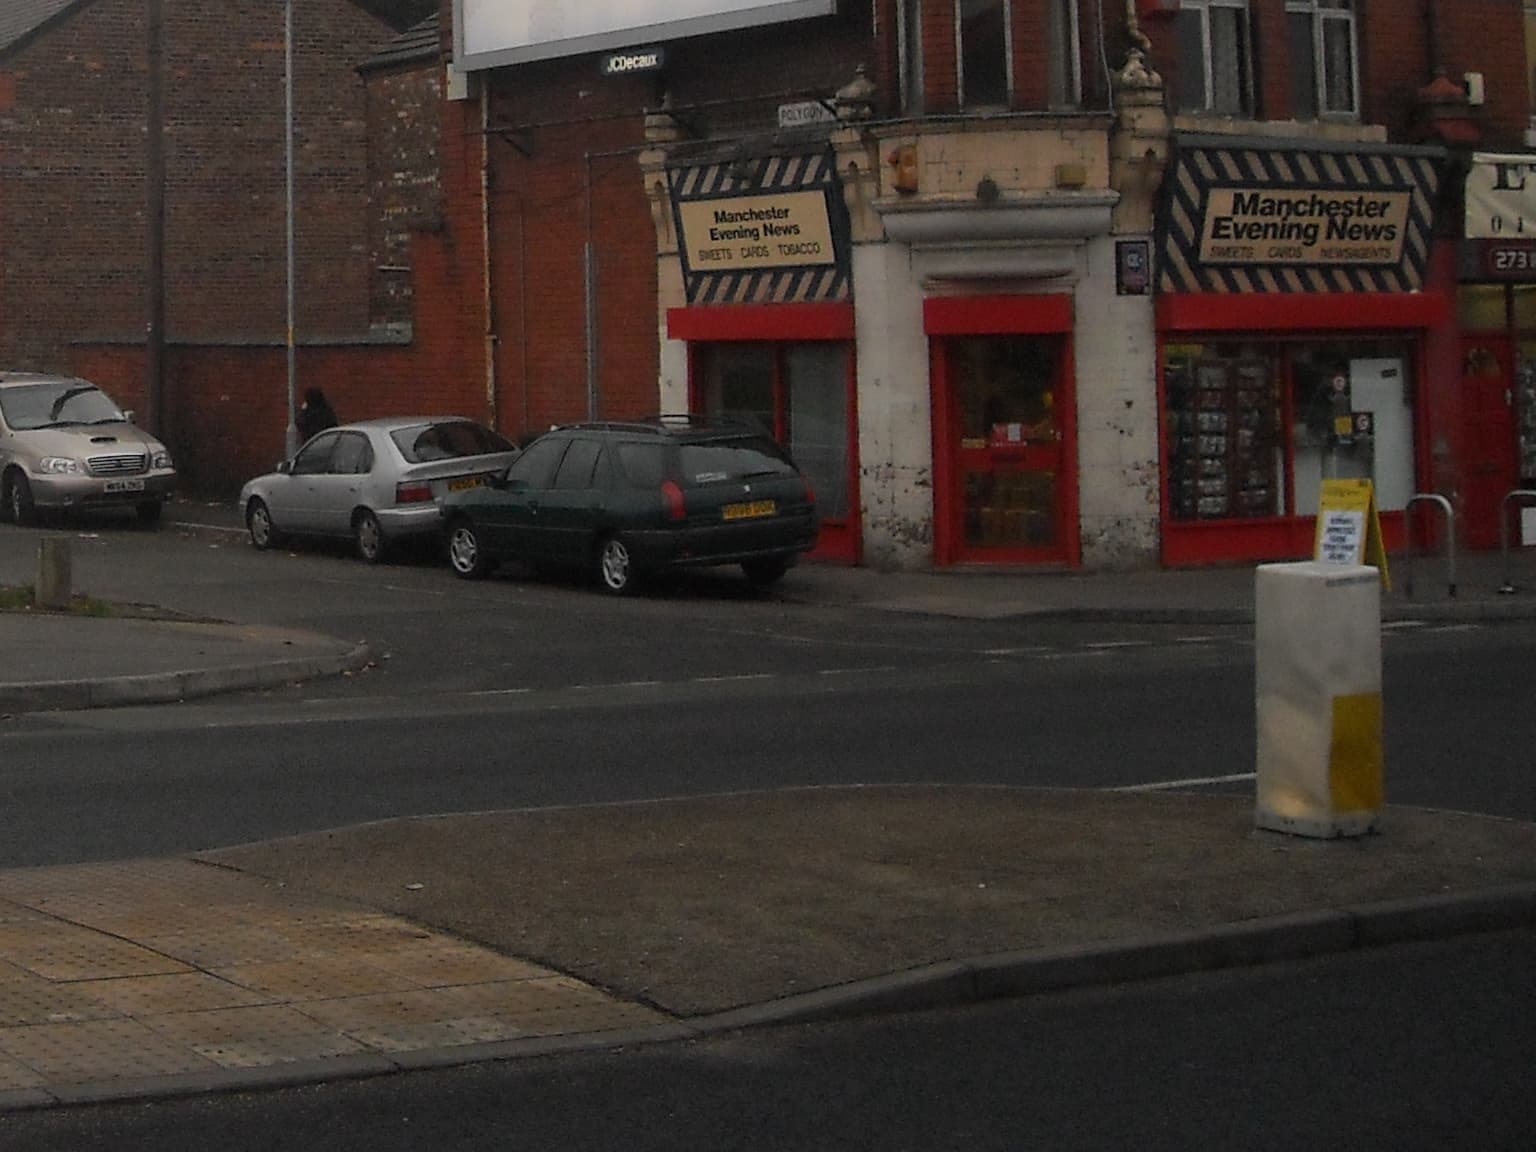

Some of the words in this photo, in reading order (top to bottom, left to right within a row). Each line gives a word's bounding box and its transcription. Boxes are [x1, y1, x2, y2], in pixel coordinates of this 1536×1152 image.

[607, 54, 657, 73] JCDecaux
[1232, 192, 1391, 218] Manchester
[714, 207, 790, 224] Manchester
[709, 224, 760, 241] Evening
[764, 222, 800, 236] News
[1211, 217, 1320, 246] Evening
[1325, 217, 1397, 241] News
[698, 250, 733, 262] SWEETS
[740, 247, 769, 259] CARDS
[777, 242, 821, 256] TOBACCO
[1210, 247, 1254, 258] SWEETS
[1268, 247, 1303, 258] CARDS
[1321, 247, 1391, 259] NEWSAGENTS
